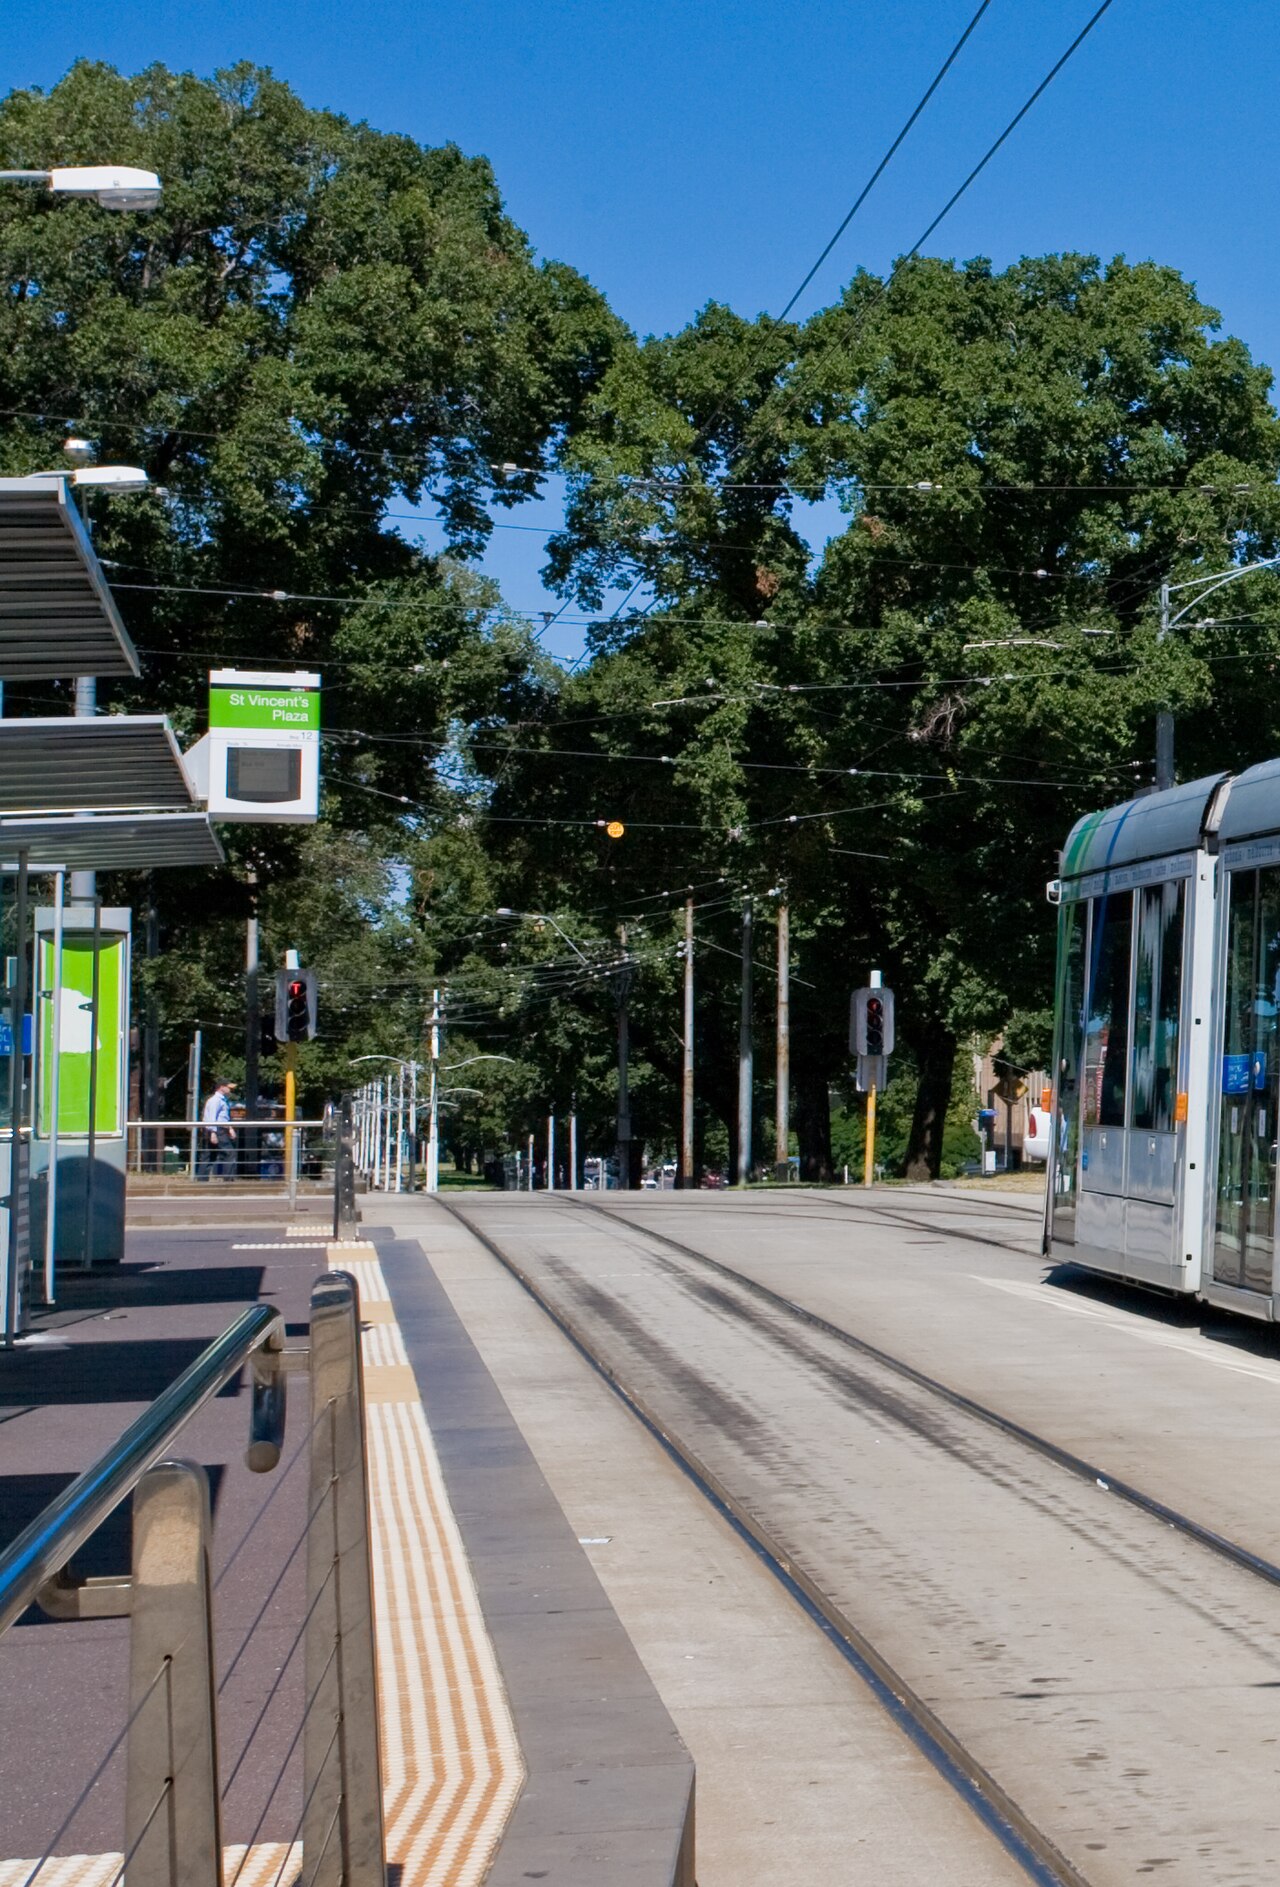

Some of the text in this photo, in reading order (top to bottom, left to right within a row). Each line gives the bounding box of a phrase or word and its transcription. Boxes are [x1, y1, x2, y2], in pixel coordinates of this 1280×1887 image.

[229, 693, 310, 708] St Vincent's
[272, 709, 309, 722] Plaza
[301, 731, 313, 740] 12
